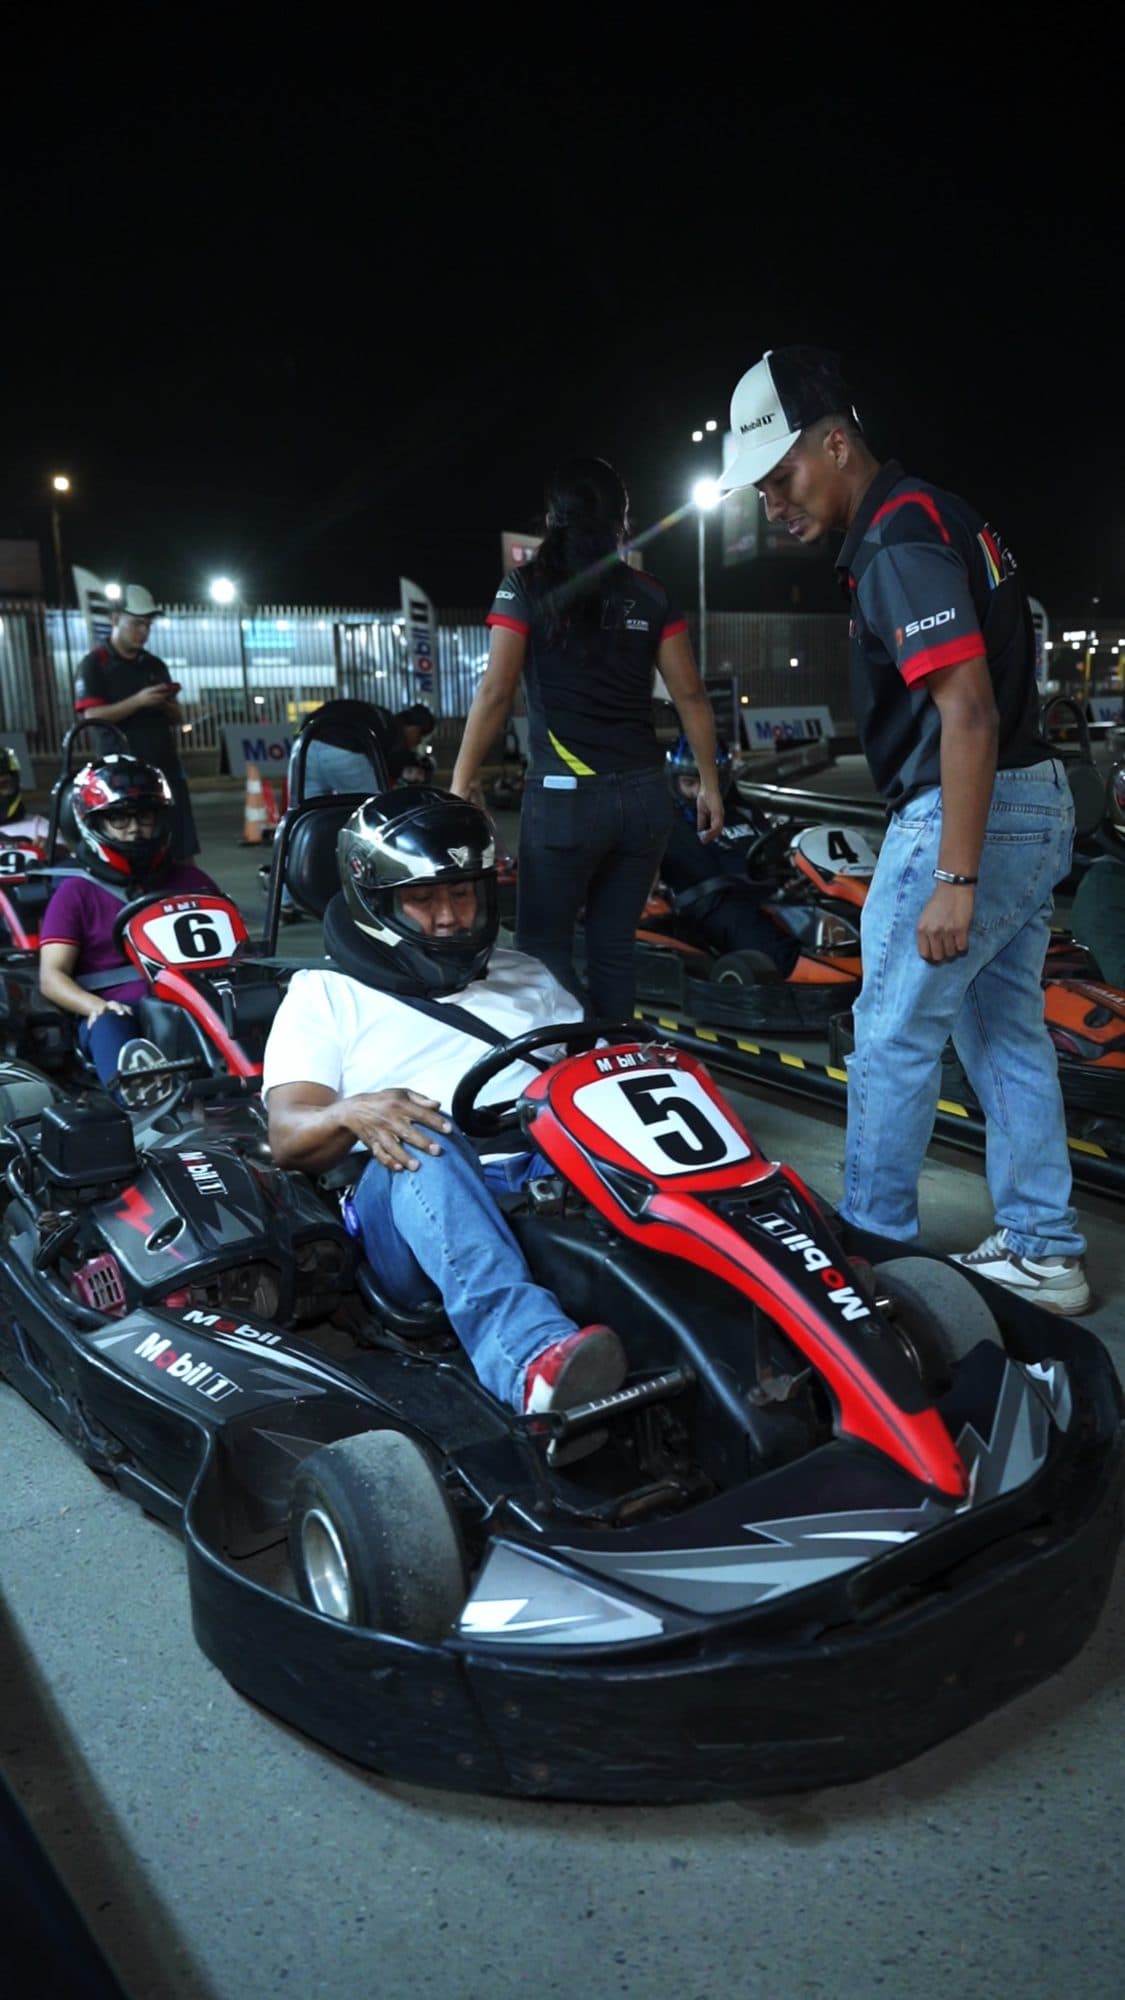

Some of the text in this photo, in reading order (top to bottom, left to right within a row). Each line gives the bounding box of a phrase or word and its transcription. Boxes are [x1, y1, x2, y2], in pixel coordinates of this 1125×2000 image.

[905, 607, 956, 638] SODI
[755, 719, 805, 739] Mobil
[0, 851, 25, 875] 9
[827, 831, 859, 864] 4
[173, 912, 222, 958] 6
[617, 1073, 728, 1166] 5
[781, 1233, 871, 1321] Mobil
[182, 1310, 282, 1345] Mobil
[134, 1332, 213, 1386] Mobil
